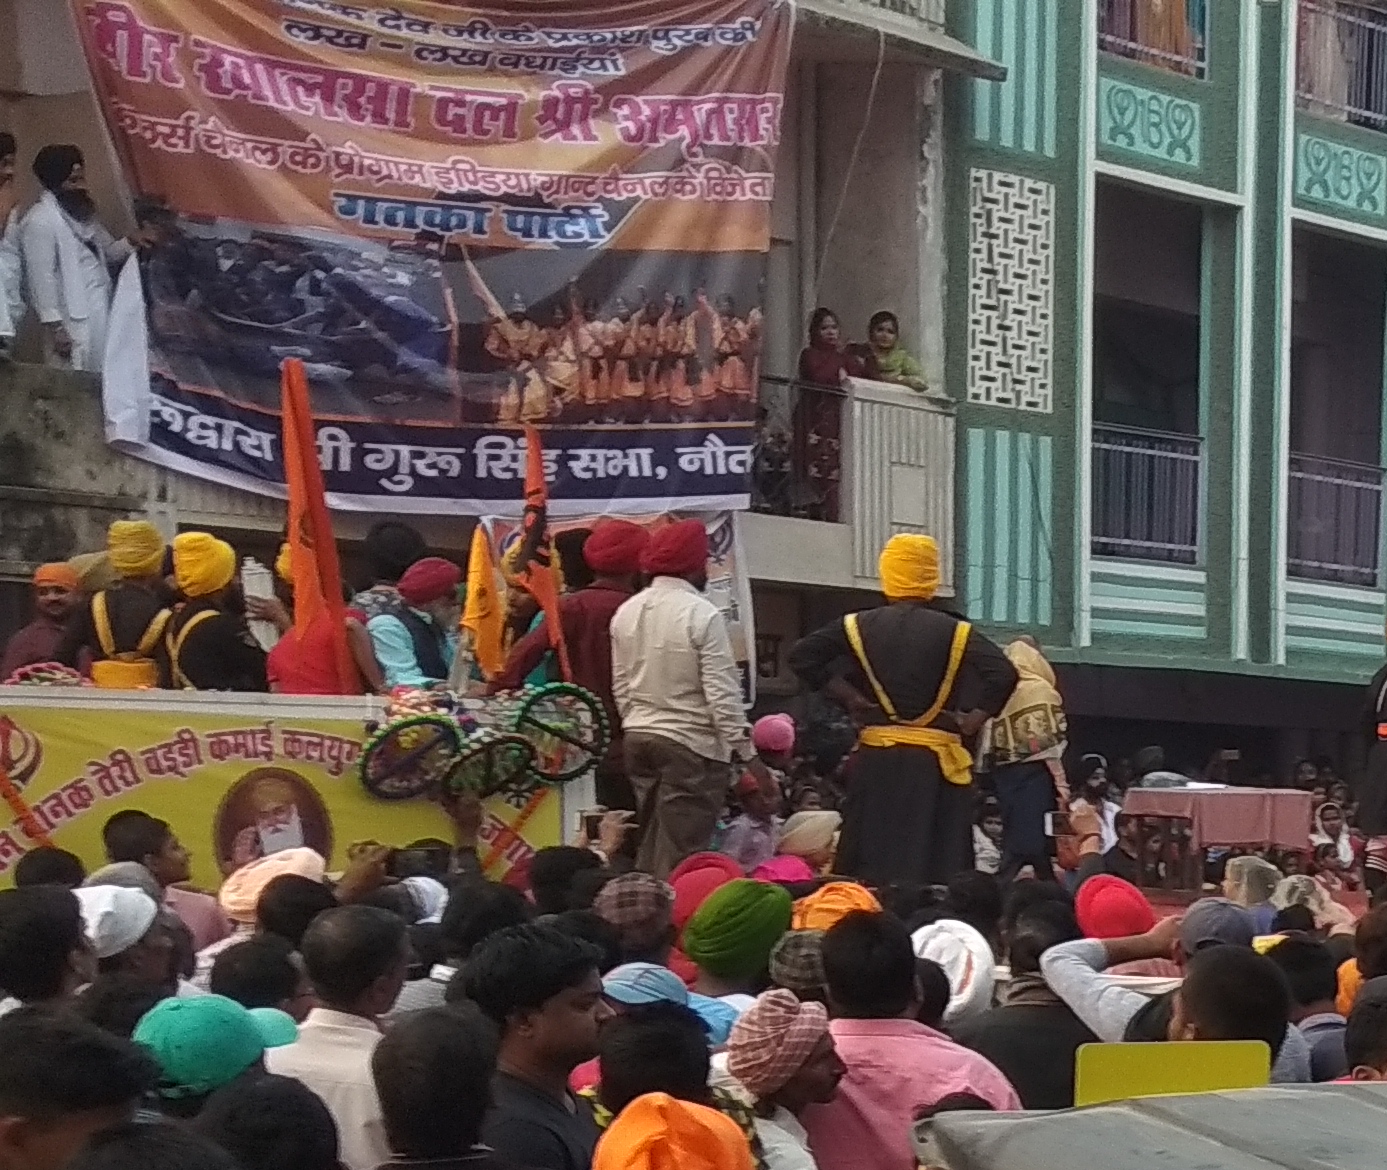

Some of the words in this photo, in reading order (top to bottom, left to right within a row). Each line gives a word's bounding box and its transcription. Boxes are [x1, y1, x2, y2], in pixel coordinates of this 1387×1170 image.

[283, 17, 373, 51] लख
[412, 42, 488, 67] लख
[441, 18, 493, 44] जी
[496, 24, 539, 45] के
[714, 17, 761, 45] की
[191, 34, 418, 130] खालसा
[426, 84, 527, 142] दल
[536, 79, 600, 143] श्री
[331, 191, 494, 237] गतका
[502, 202, 610, 247] पार्टी
